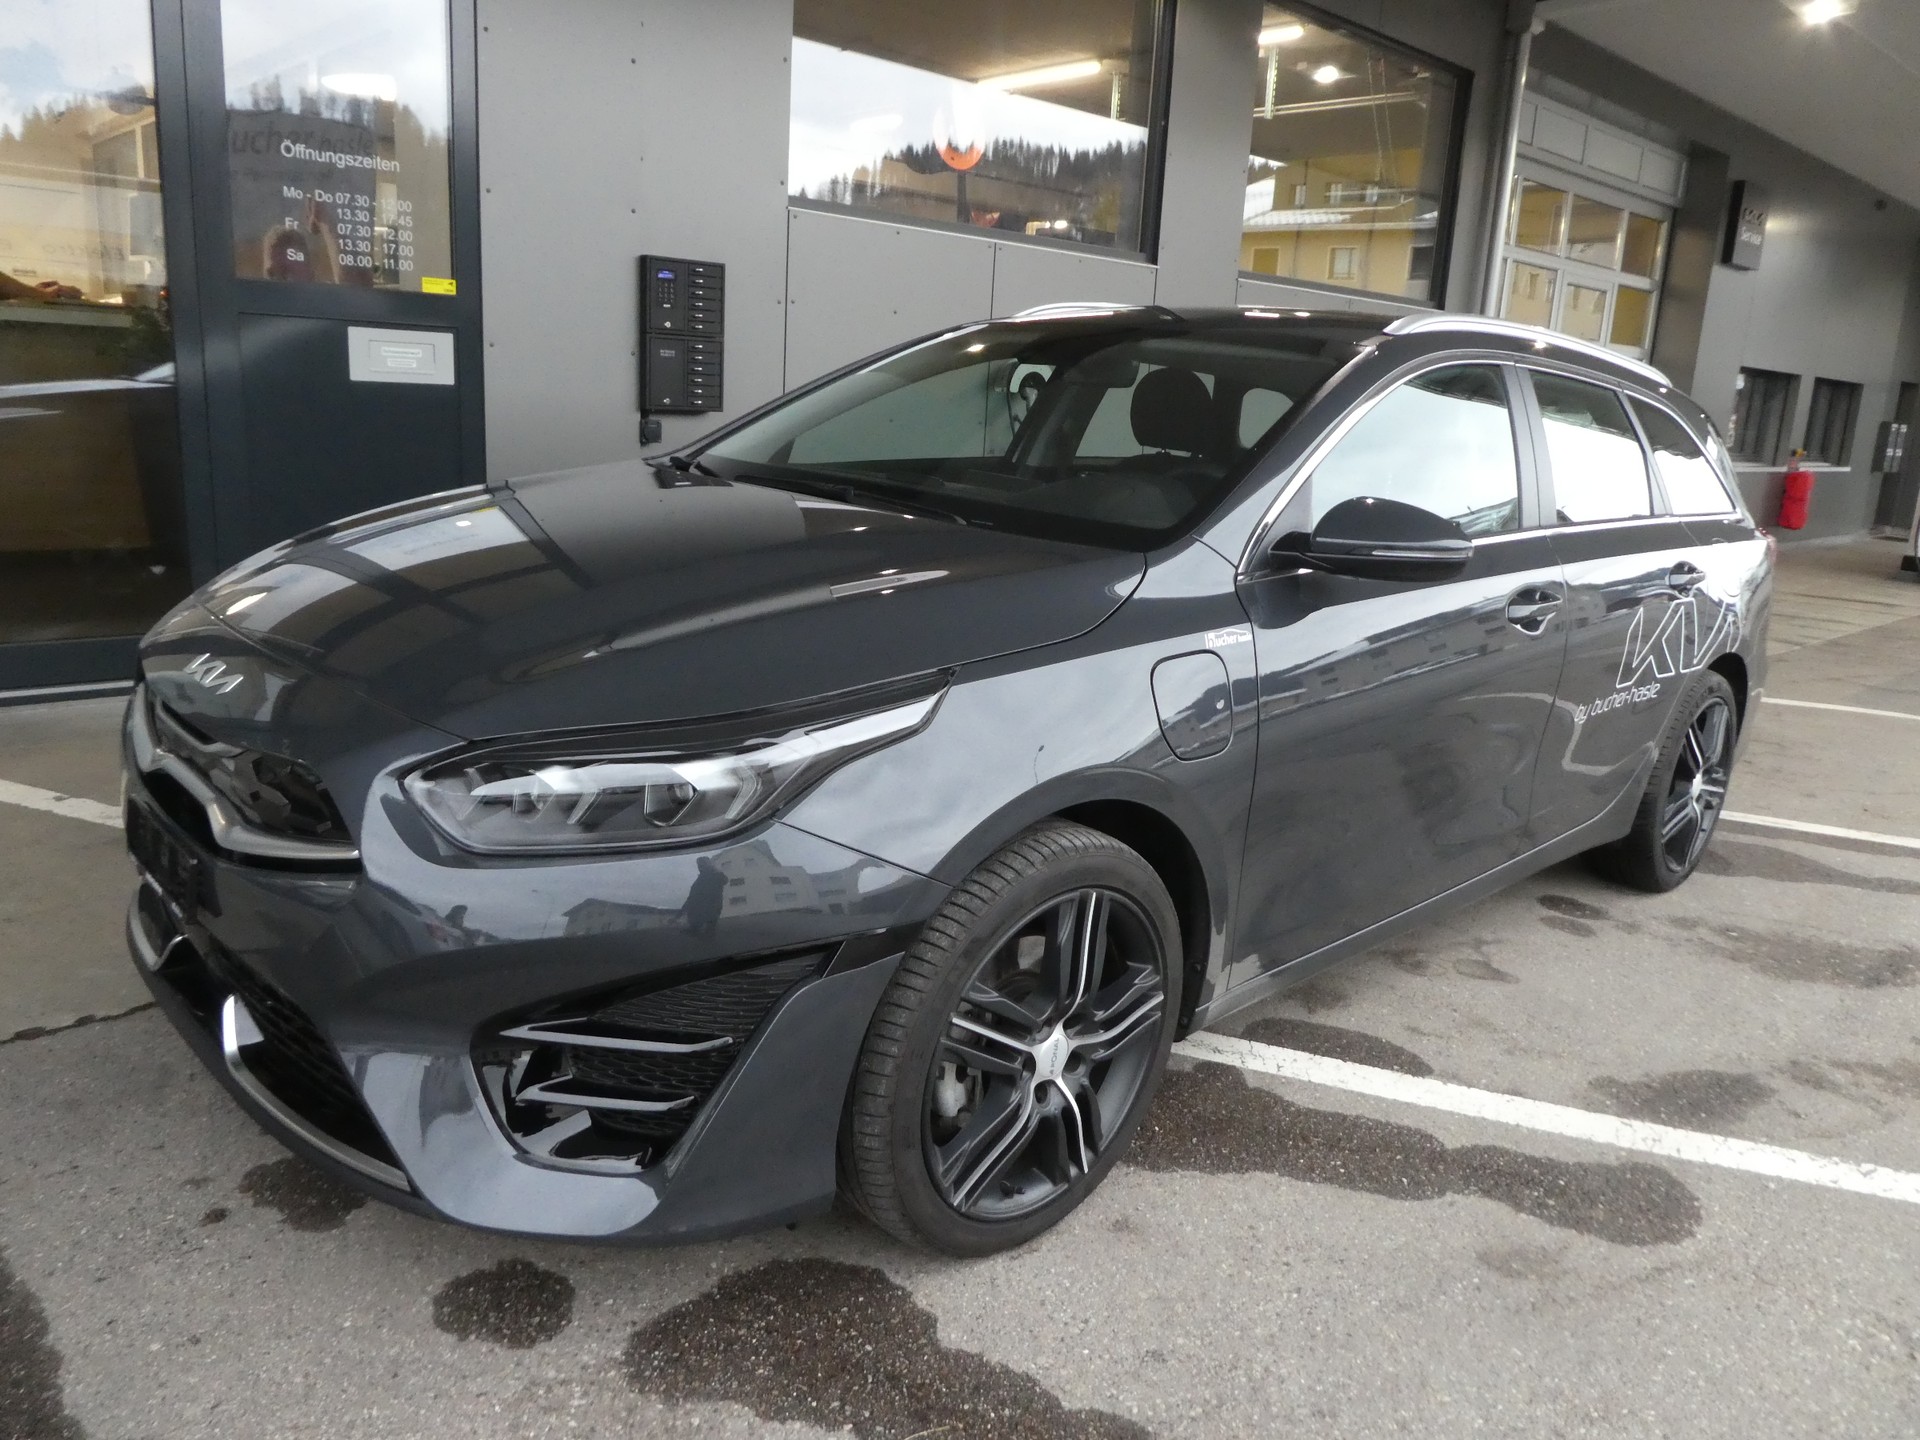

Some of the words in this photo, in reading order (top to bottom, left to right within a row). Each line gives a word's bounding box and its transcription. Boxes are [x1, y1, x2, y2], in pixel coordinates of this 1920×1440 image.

[280, 140, 400, 172] Öffnungszeiten
[283, 186, 303, 200] Mo
[315, 189, 333, 203] Do
[336, 192, 370, 208] 07.30
[337, 208, 370, 223] 13.30
[285, 217, 299, 230] Fr
[337, 223, 371, 238] 07.30
[338, 239, 371, 253] 13.30
[382, 243, 414, 257] 17.00
[287, 249, 304, 262] Sa
[339, 254, 372, 268] 08.00
[383, 258, 414, 272] 11.00
[1574, 703, 1592, 724] by
